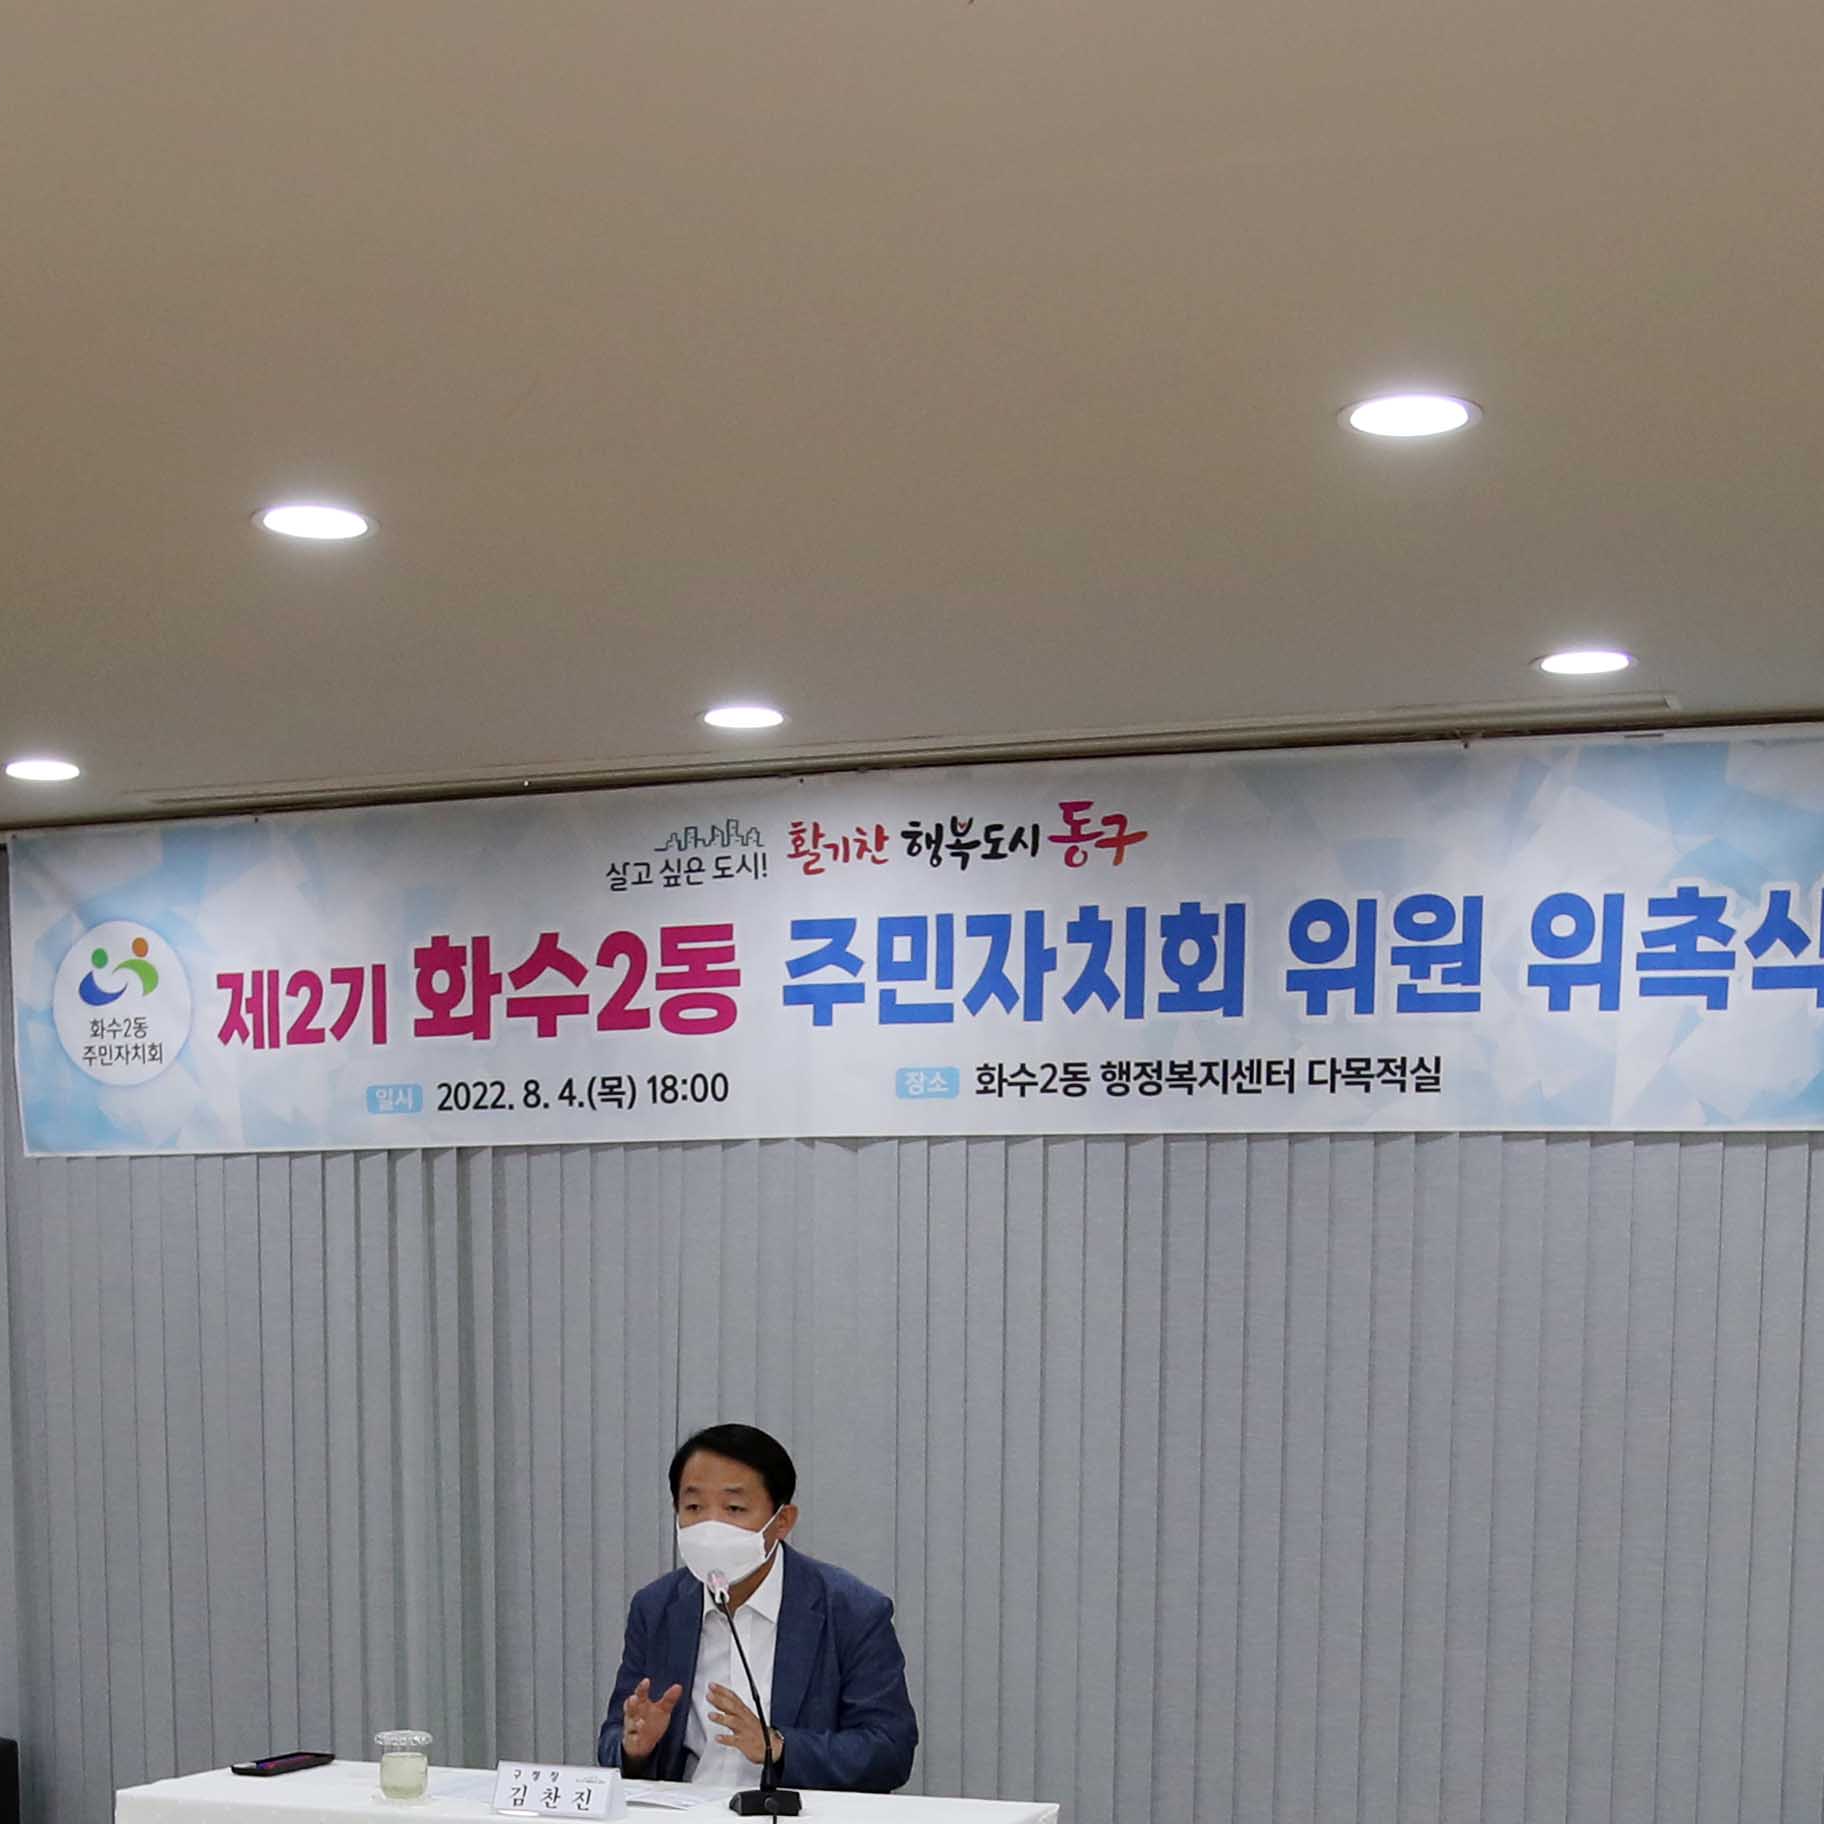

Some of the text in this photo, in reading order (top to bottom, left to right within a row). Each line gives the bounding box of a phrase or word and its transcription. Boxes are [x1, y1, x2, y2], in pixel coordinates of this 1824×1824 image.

[606, 800, 1148, 892] 살고 싶은 도시! 활기찬 행복도시 동구
[216, 963, 387, 1050] 제2기
[413, 922, 741, 1040] 화수2동
[783, 902, 1246, 1026] 주민자치회
[1286, 893, 1484, 1016] 위원
[89, 1016, 149, 1040] 화수2동
[82, 1042, 164, 1066] 주민자치회
[375, 1072, 729, 1113] 일시 2022. 8. 4.(목) 18:00
[904, 1056, 1442, 1098] 장소 화수2동 행정복지센터 다목적실
[509, 1783, 592, 1811] 김찬진
